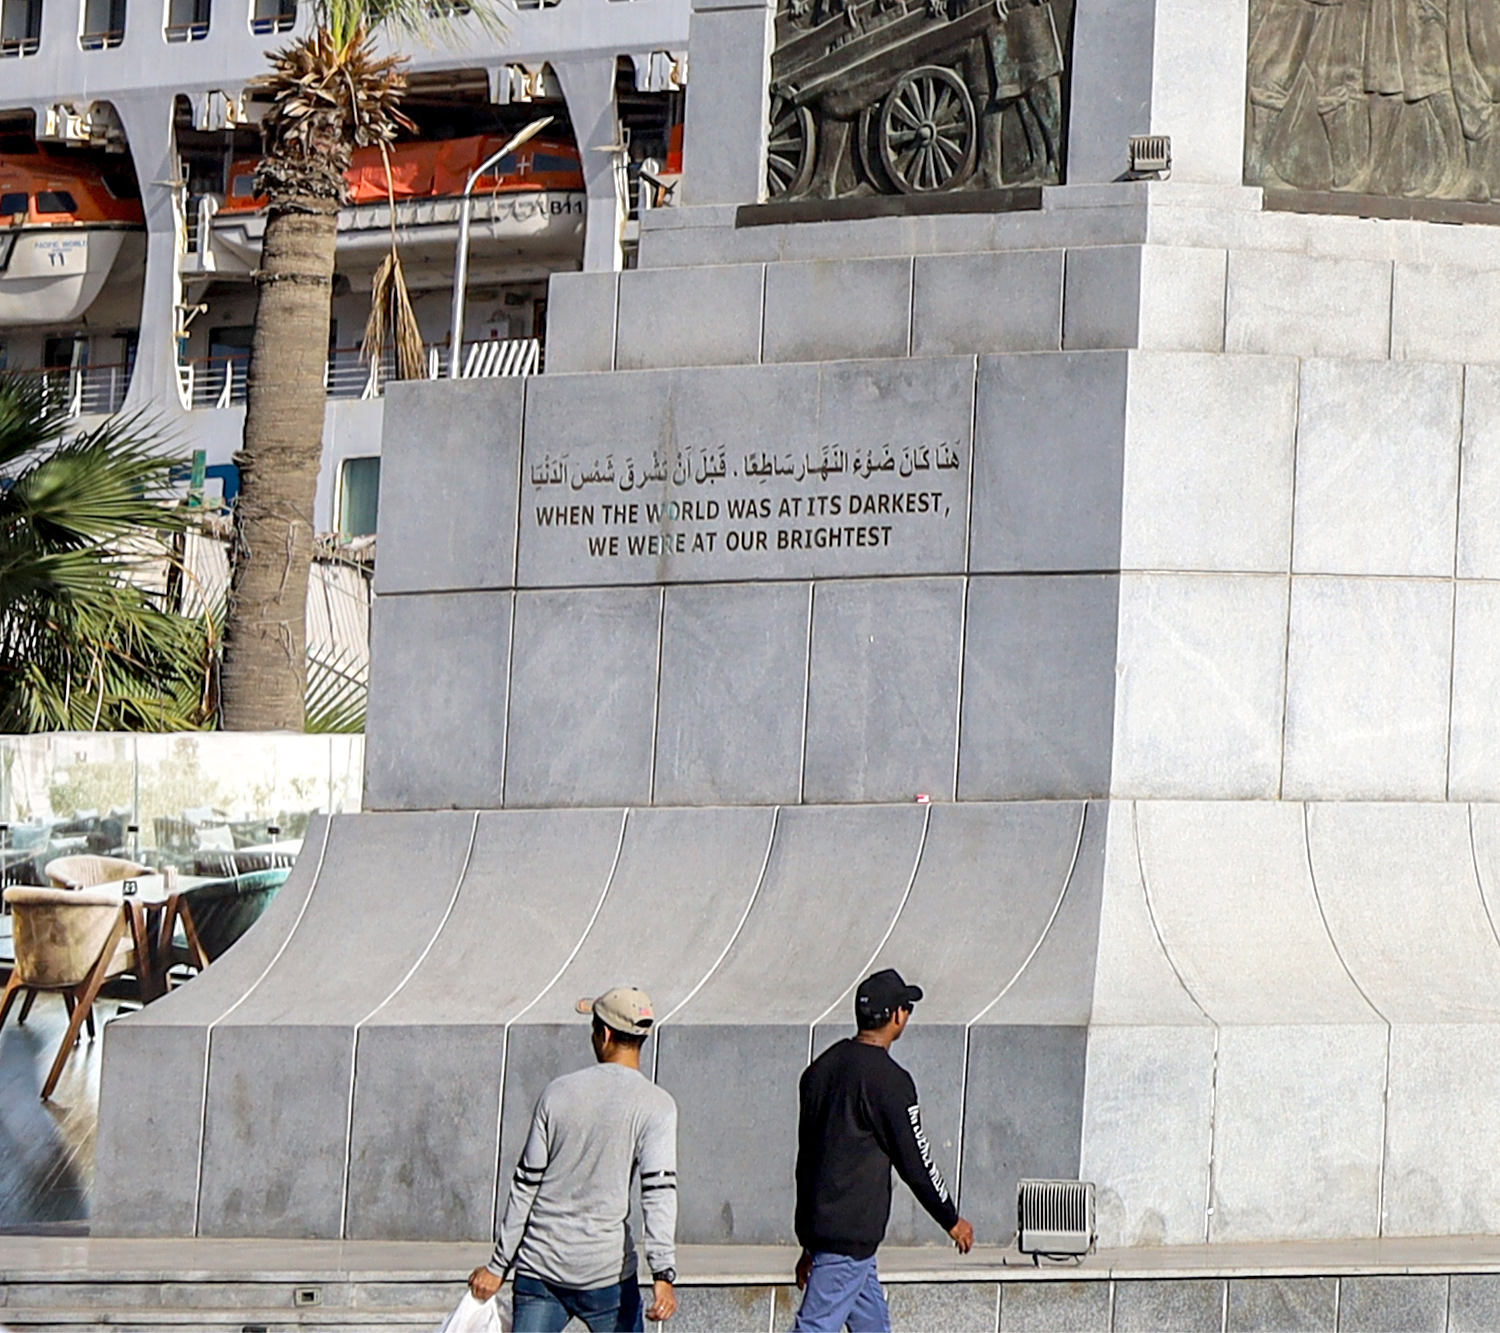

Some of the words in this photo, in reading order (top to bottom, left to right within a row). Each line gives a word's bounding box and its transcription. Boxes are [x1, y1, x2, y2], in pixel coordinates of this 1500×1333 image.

[536, 505, 595, 526] WHEN
[602, 503, 639, 525] THE
[646, 500, 720, 524] WORLD
[727, 498, 771, 520] WAS
[778, 497, 802, 517] AT
[807, 495, 842, 517] ITS
[849, 492, 951, 518] DARKEST,
[588, 536, 619, 557] WE
[627, 533, 686, 556] WERE
[691, 532, 717, 553] AT
[726, 530, 767, 552] OUR
[777, 526, 893, 550] BRIGHTEST
